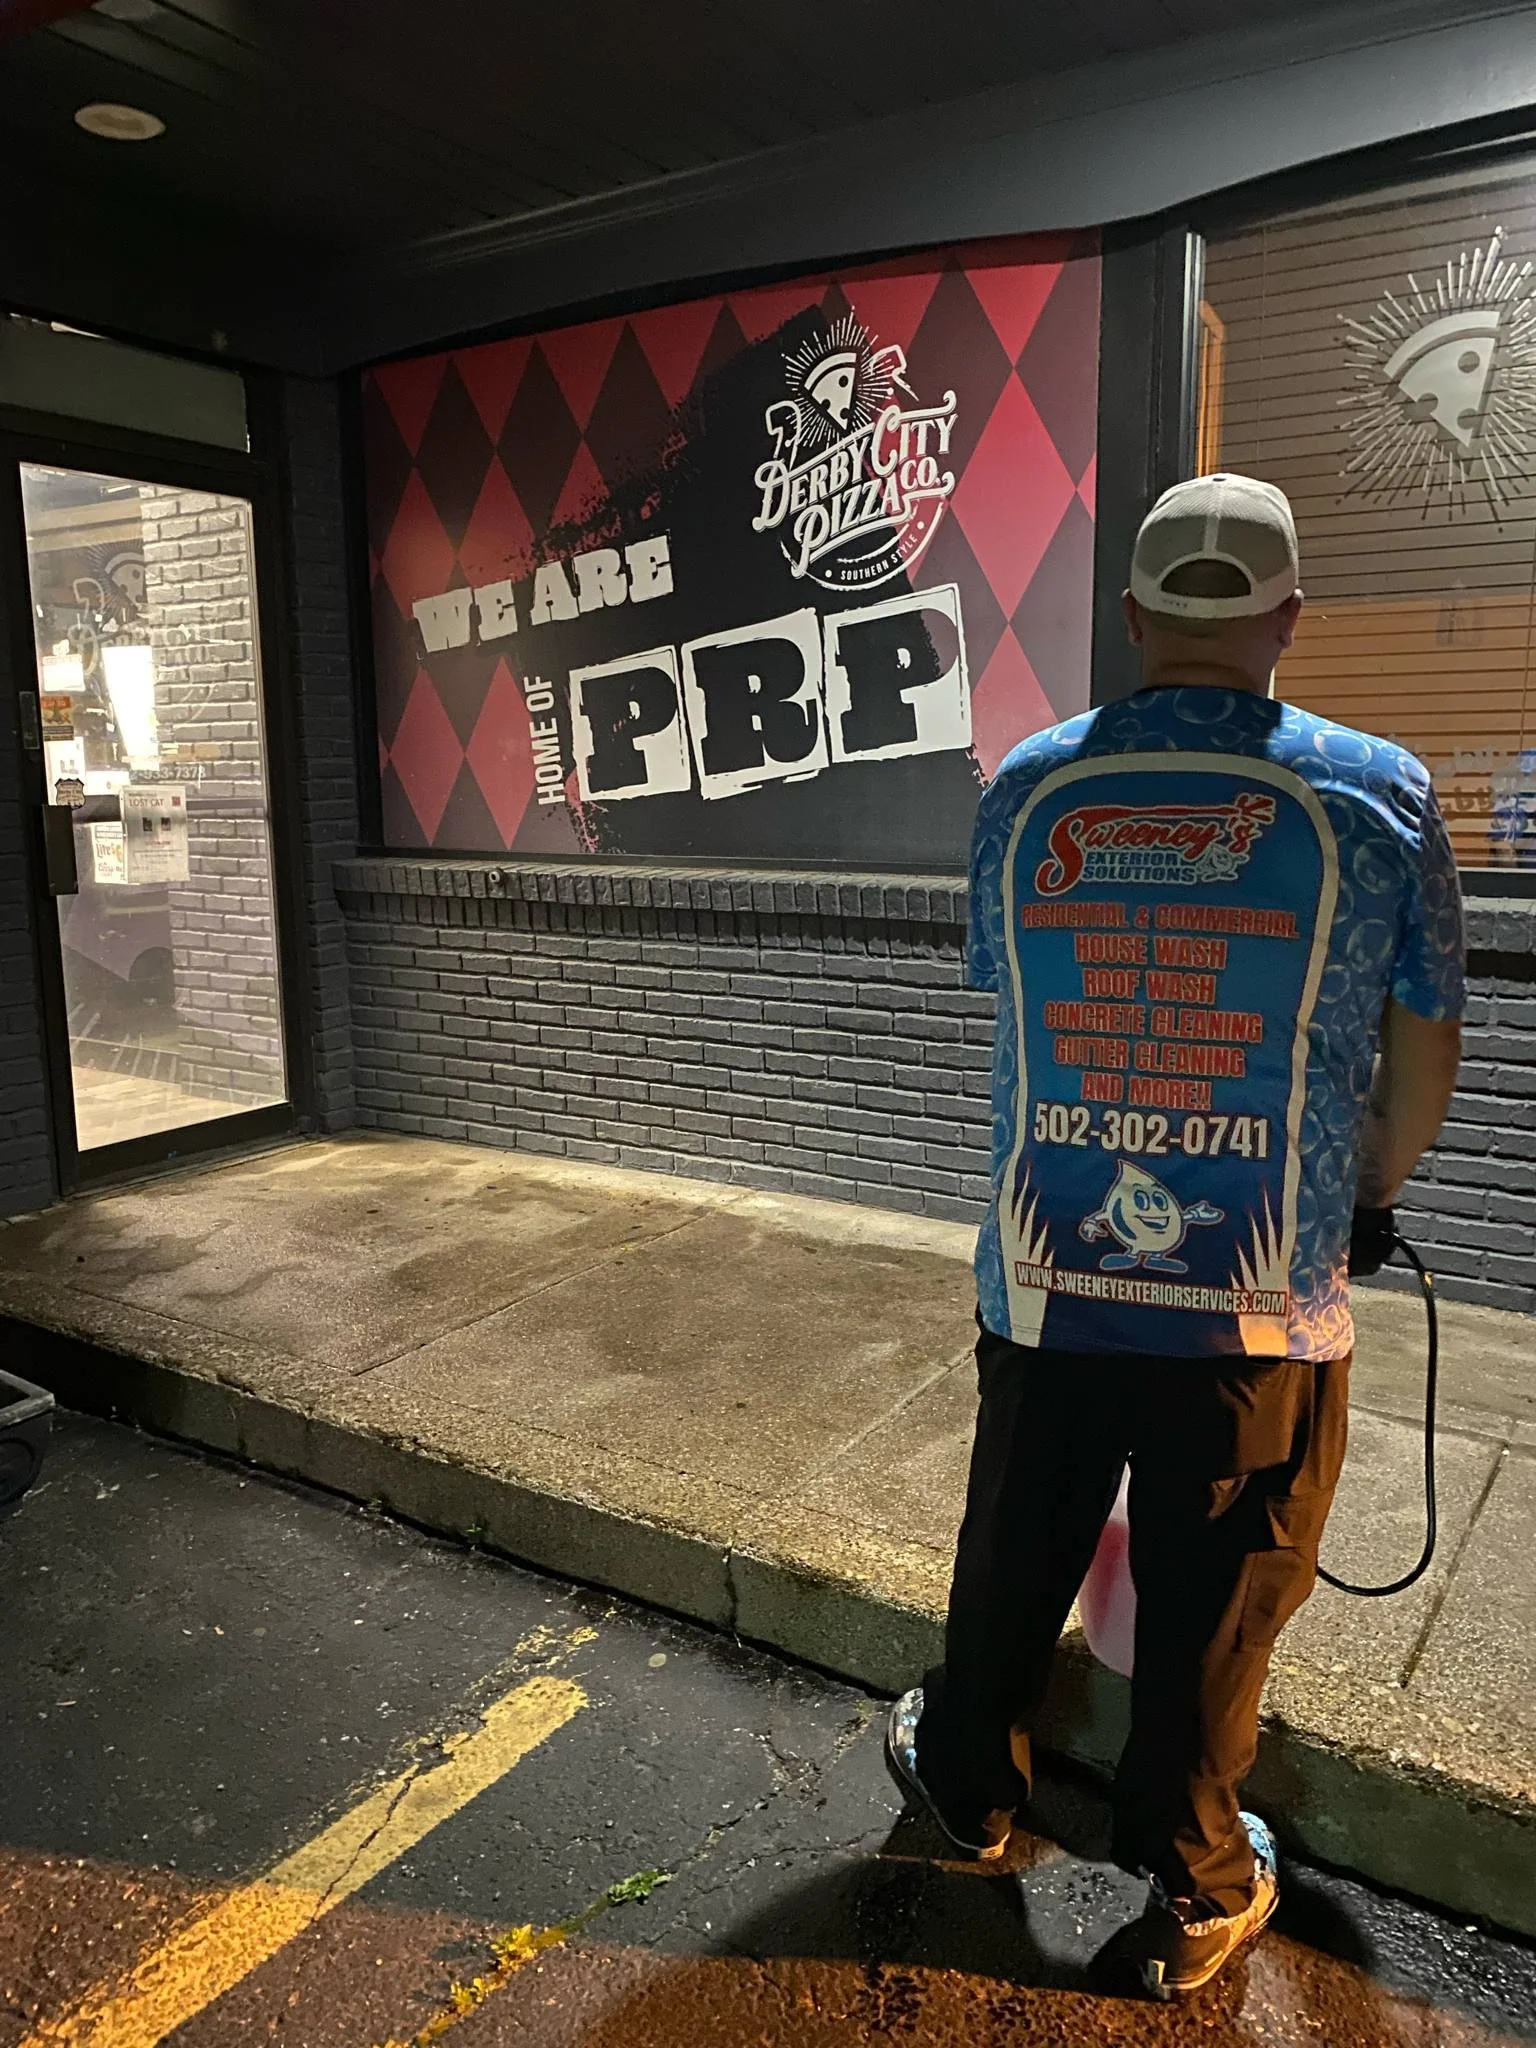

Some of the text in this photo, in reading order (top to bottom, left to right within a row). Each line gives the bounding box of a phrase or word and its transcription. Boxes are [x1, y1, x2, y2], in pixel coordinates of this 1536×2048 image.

[752, 390, 958, 532] DERBY CITY
[791, 456, 941, 578] PIZZA CO.
[840, 533, 918, 580] SOUTHERN STYLE
[413, 535, 675, 653] WE ARE
[576, 605, 962, 794] PRP
[523, 675, 566, 804] HOME OF
[128, 799, 164, 807] LOST CAT
[1081, 865, 1197, 883] SOLUTIONS
[1084, 850, 1179, 867] EXTERIOR
[1022, 903, 1299, 939] RESIDENTIAL & COMMERCIAL
[1075, 933, 1228, 970] HOUSE WASH
[1083, 968, 1216, 1003] ROOF WASH
[1044, 1002, 1263, 1043] CONCRETE CLEANING
[1054, 1035, 1246, 1077] GUTTER CLEANING
[1081, 1072, 1123, 1101] AND
[1033, 1102, 1269, 1159] 502-302-0741
[1015, 1263, 1286, 1315] WWW.SWEENEYEXTERIORSERVICES.COM
